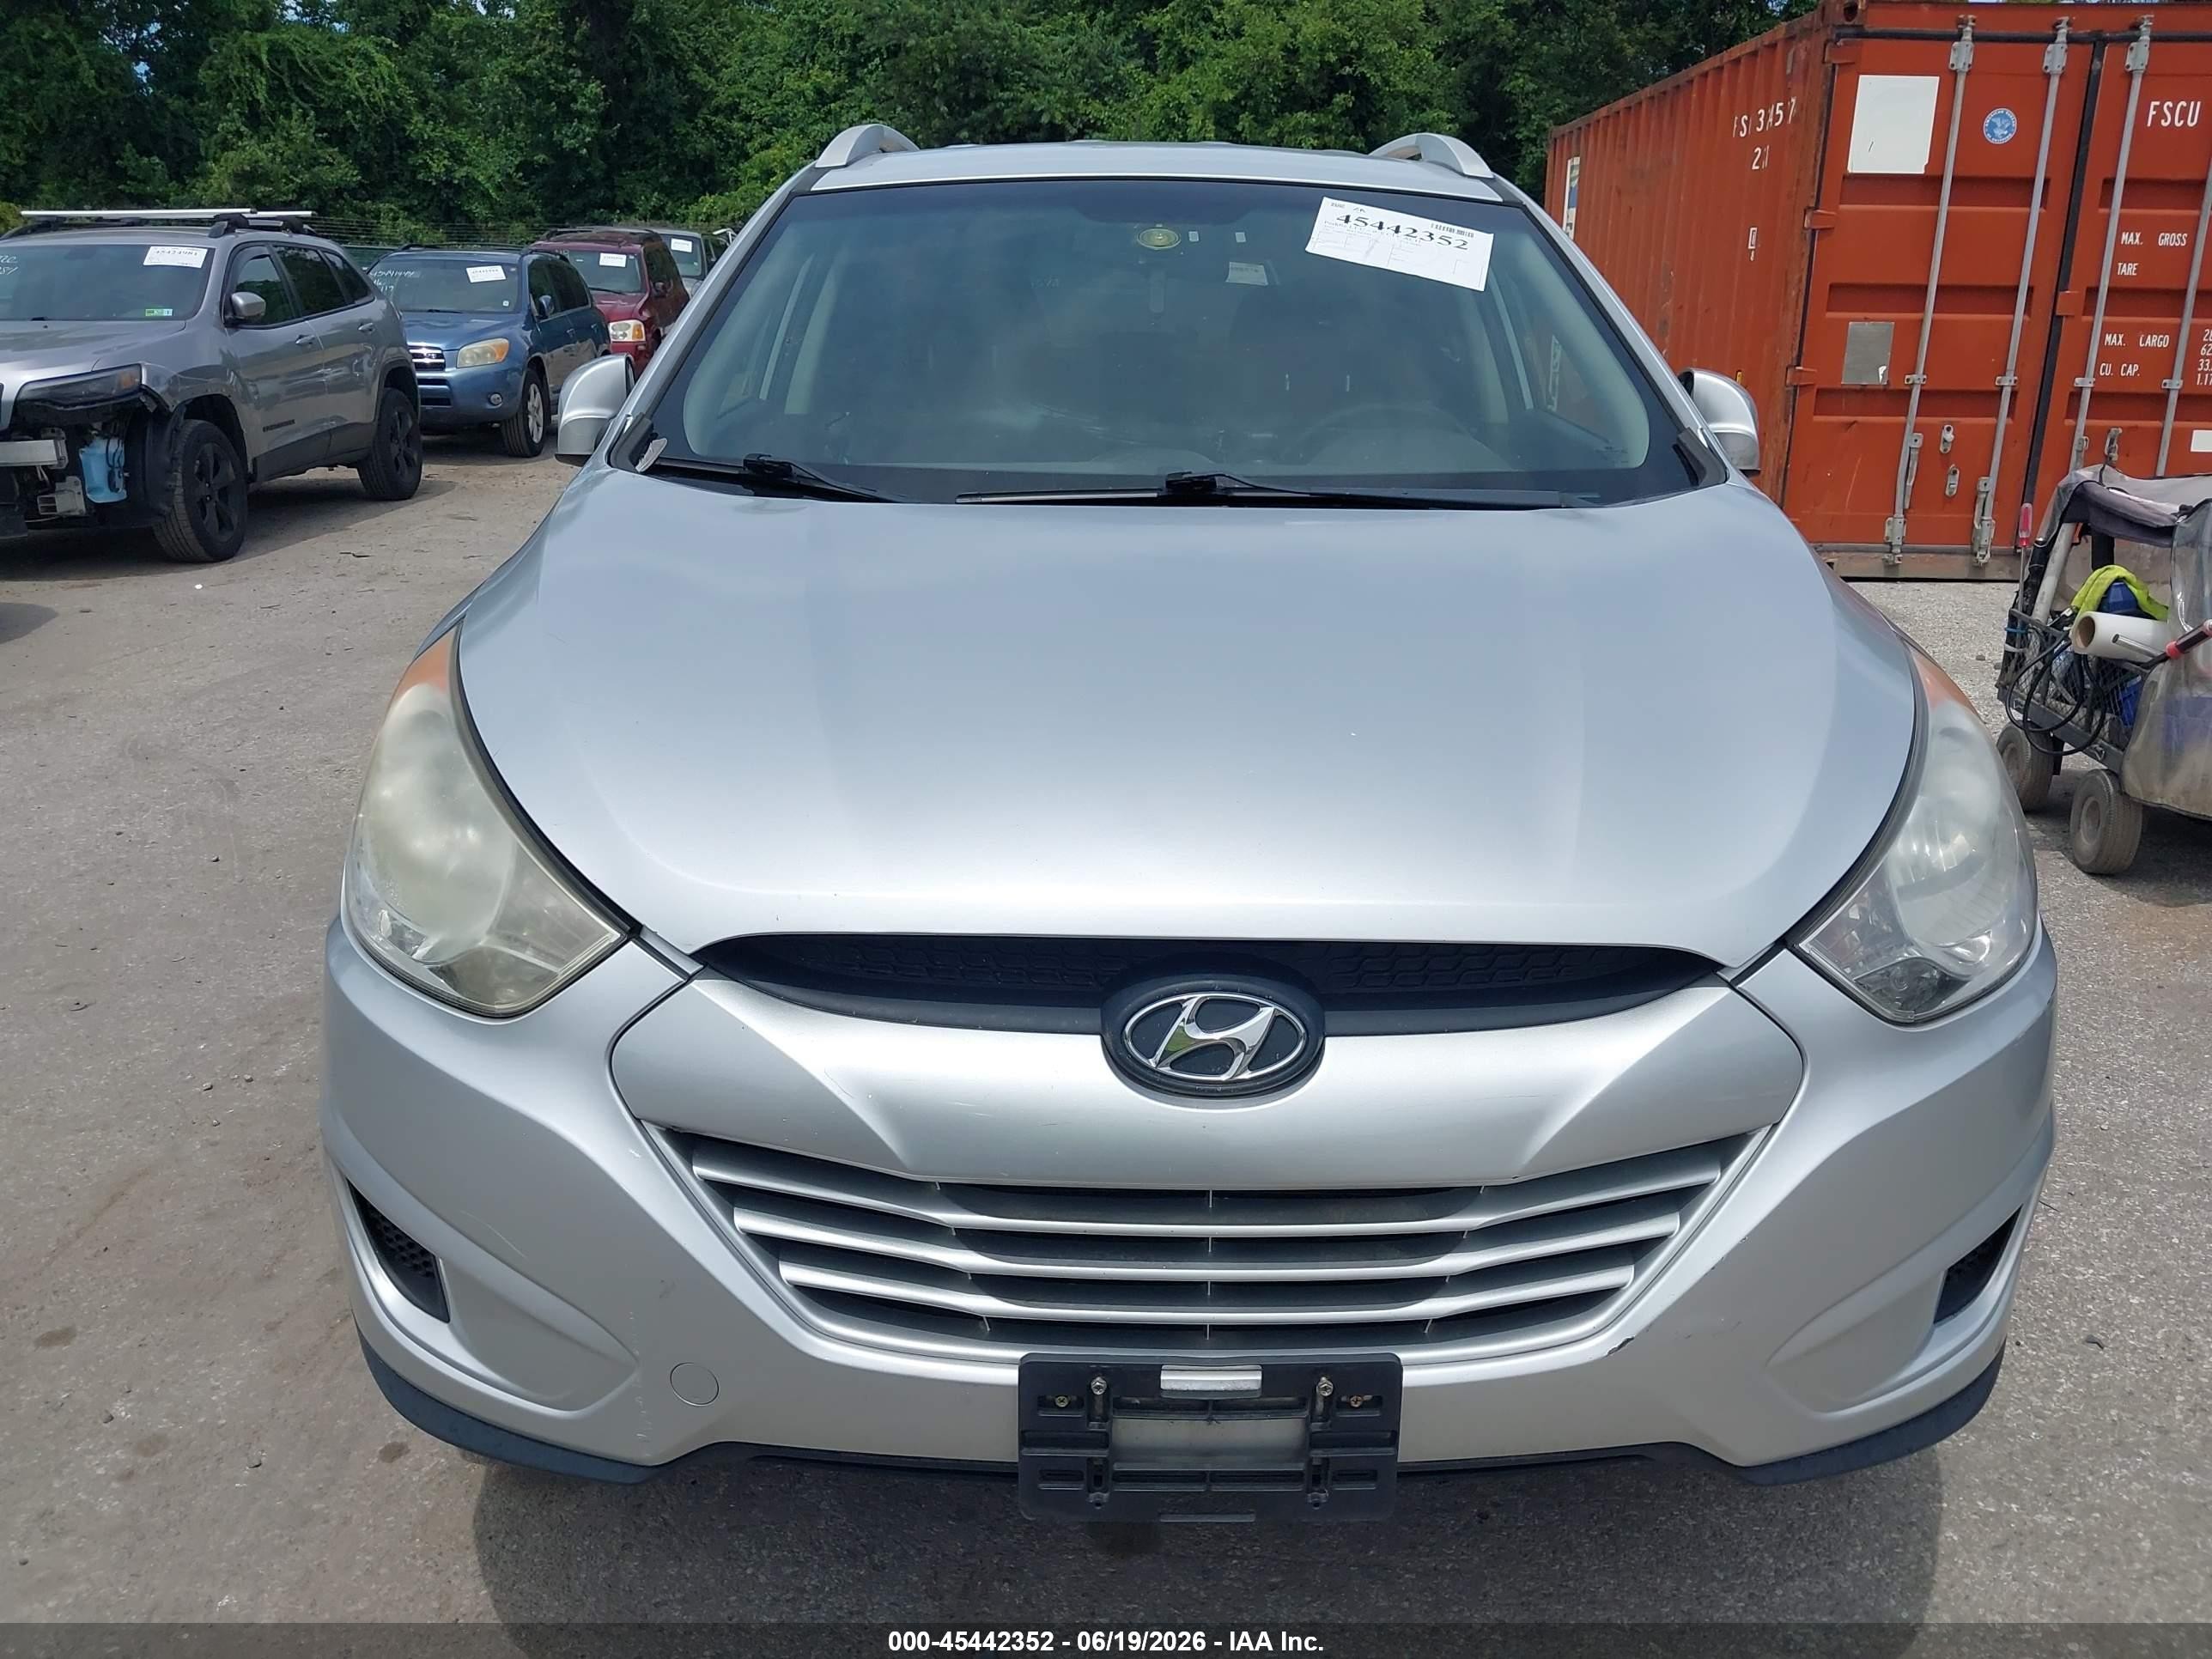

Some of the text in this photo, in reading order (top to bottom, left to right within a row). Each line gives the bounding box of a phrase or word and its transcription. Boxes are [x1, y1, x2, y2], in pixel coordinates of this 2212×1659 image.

[2147, 100, 2201, 128] FSCU
[1336, 214, 1469, 251] 45442352
[2121, 231, 2188, 246] MAX. GROSS
[2117, 262, 2139, 276] TARE
[2104, 333, 2170, 348] MAX. CARGO
[2100, 362, 2141, 377] CU. CAP.
